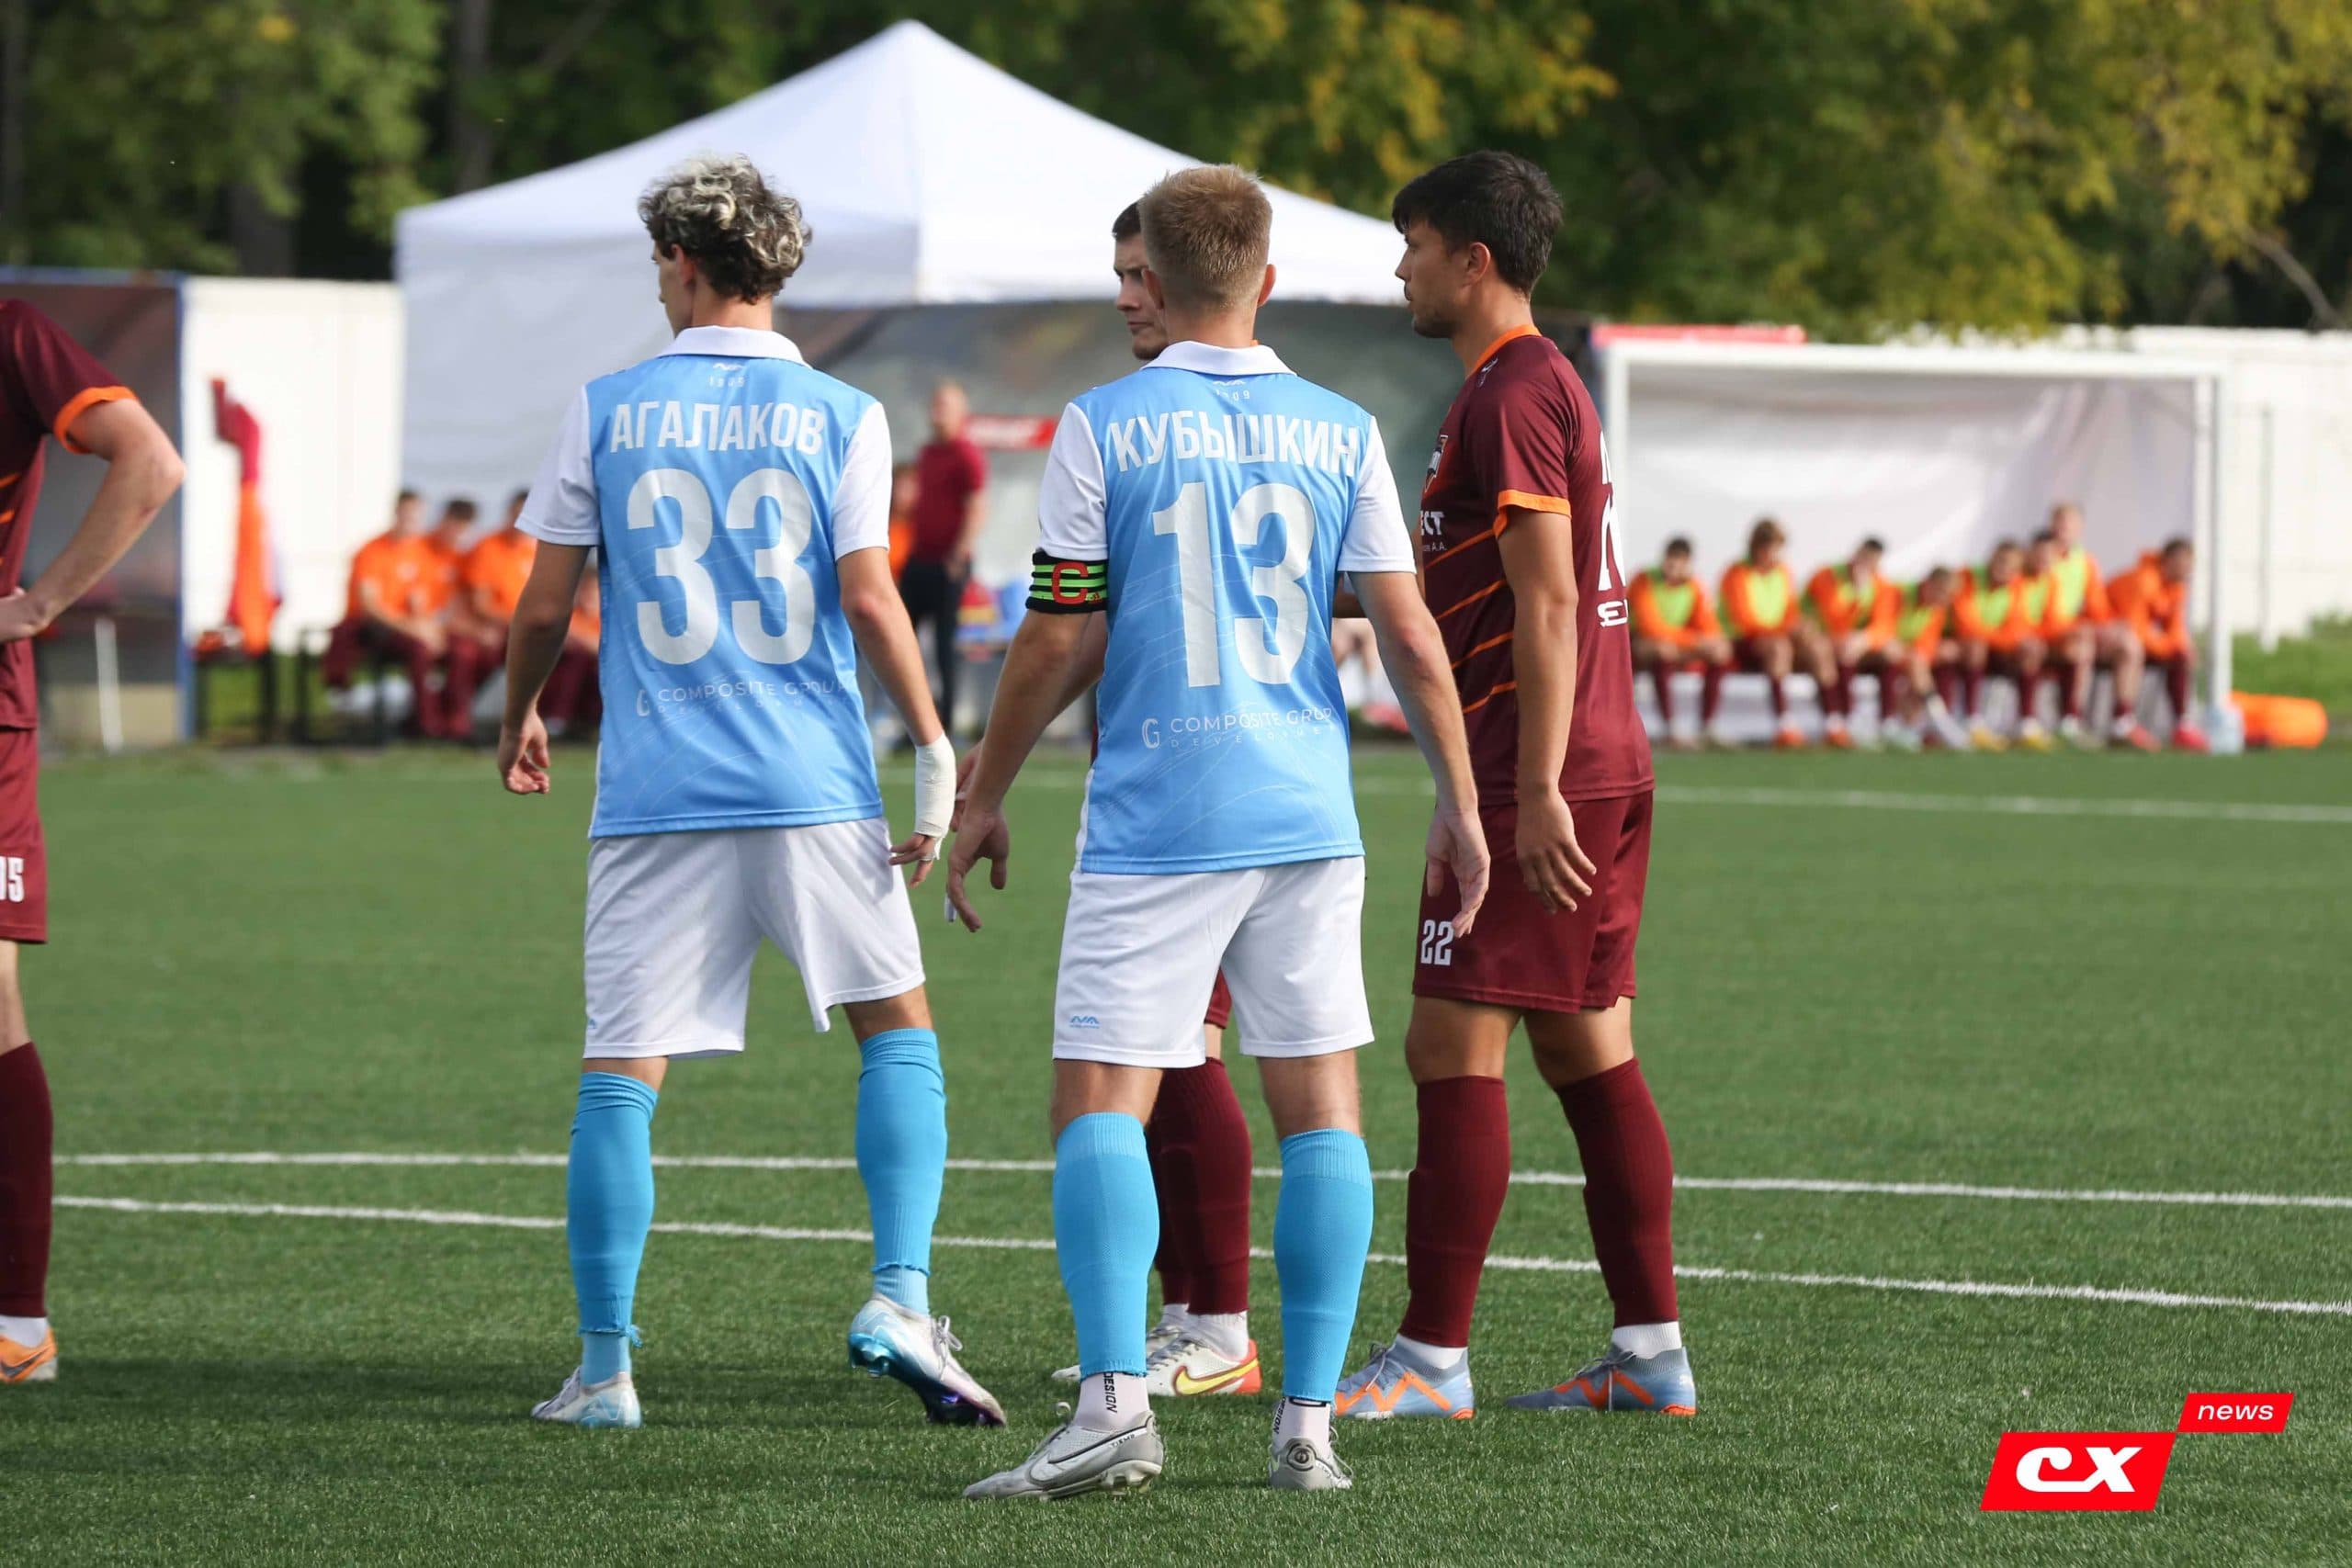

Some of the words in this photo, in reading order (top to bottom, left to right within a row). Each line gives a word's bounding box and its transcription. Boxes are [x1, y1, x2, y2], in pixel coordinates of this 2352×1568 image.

[610, 400, 824, 456] АГАЛАКОВ
[1109, 410, 1358, 478] КУБЫШКИН
[627, 468, 816, 665] 33
[1052, 561, 1089, 604] C
[1153, 481, 1315, 688] 13
[1170, 712, 1281, 733] COMPOSITE
[1420, 919, 1454, 965] 22
[1103, 1371, 1118, 1414] DESIGN
